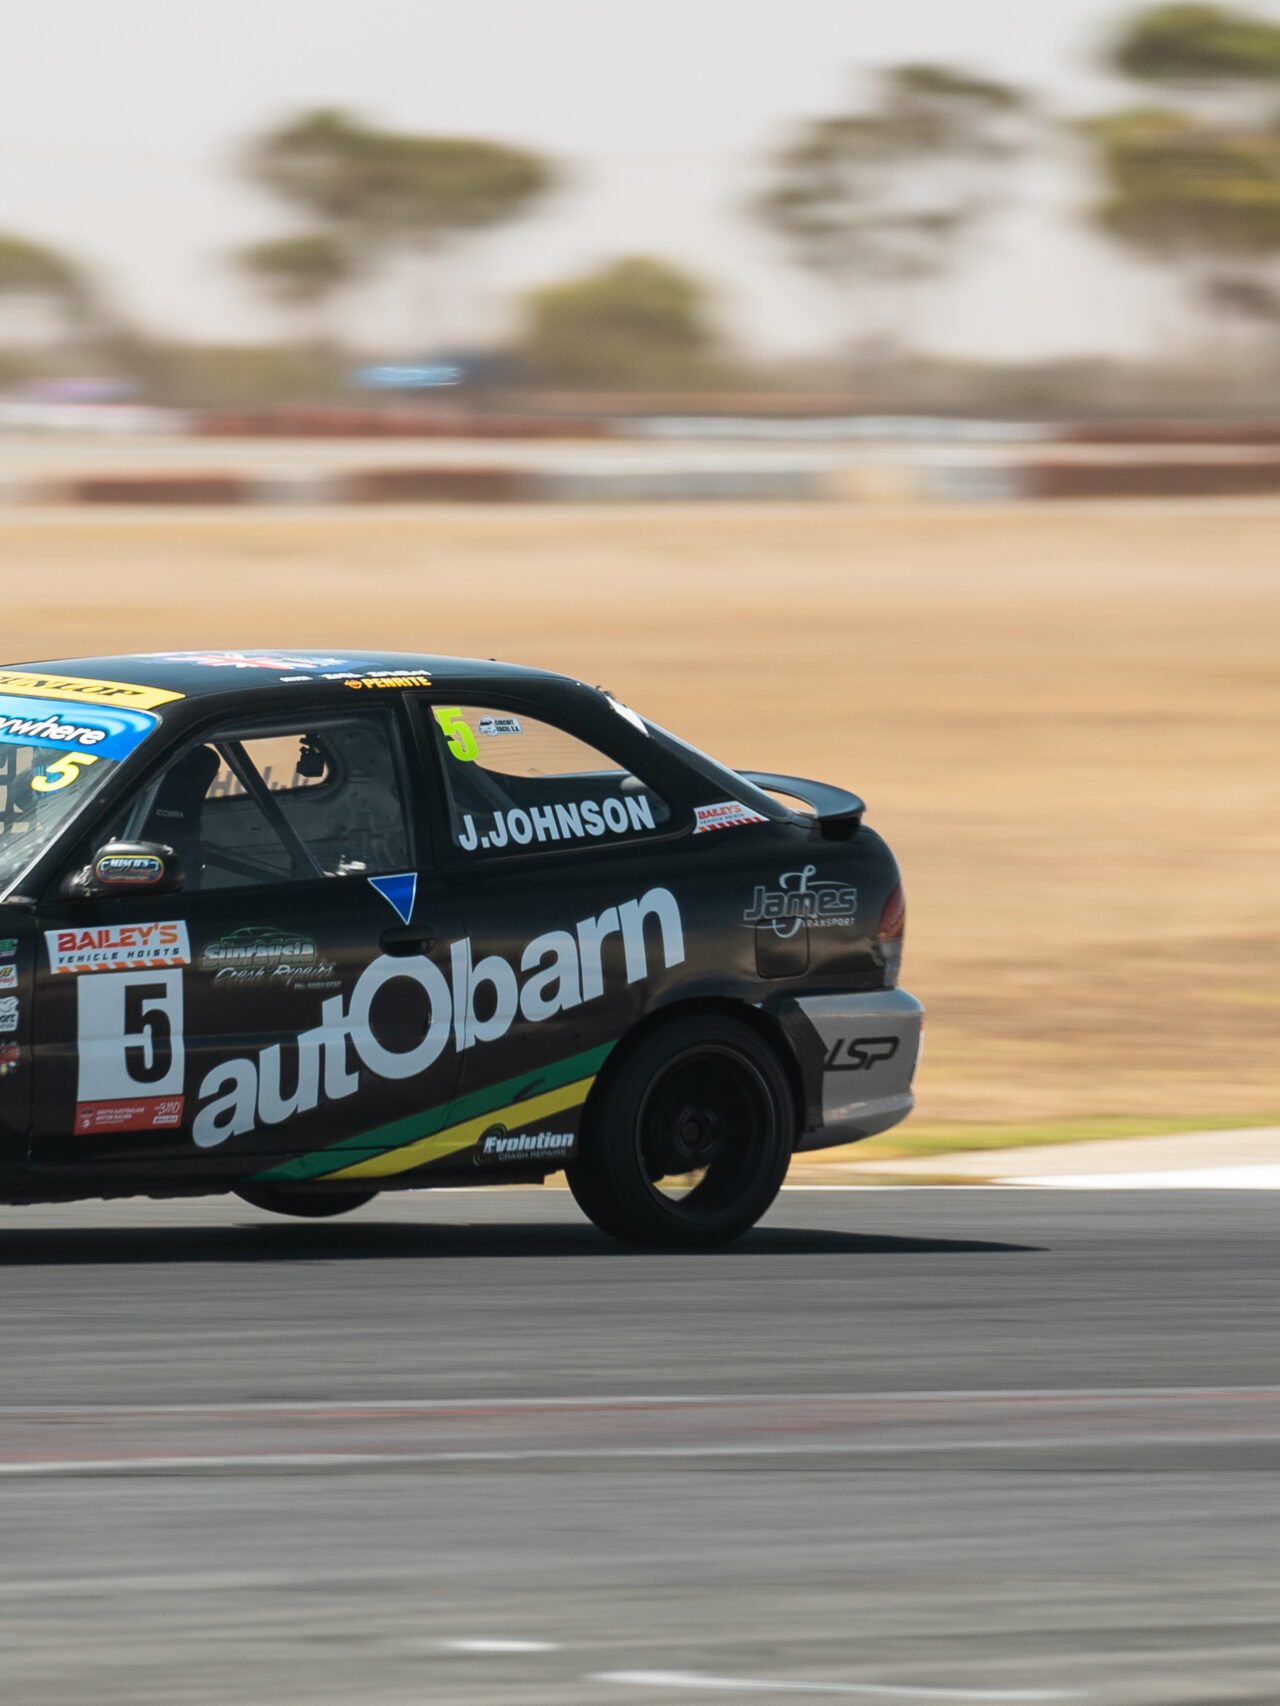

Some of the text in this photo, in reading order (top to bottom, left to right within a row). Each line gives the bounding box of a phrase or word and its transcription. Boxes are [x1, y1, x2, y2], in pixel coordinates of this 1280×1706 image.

[361, 676, 432, 689] PENRITE
[434, 706, 479, 762] 5
[31, 751, 98, 793] 5
[458, 795, 656, 851] J.JOHNSON
[698, 804, 742, 819] BAILEY'S
[58, 922, 178, 953] BAILEY'S
[58, 947, 181, 964] VEHICLE HOISTS
[201, 942, 316, 970] Sunraysia
[124, 982, 173, 1084] 5
[483, 1132, 575, 1155] Evolution
[530, 1149, 567, 1159] REPAIRS
